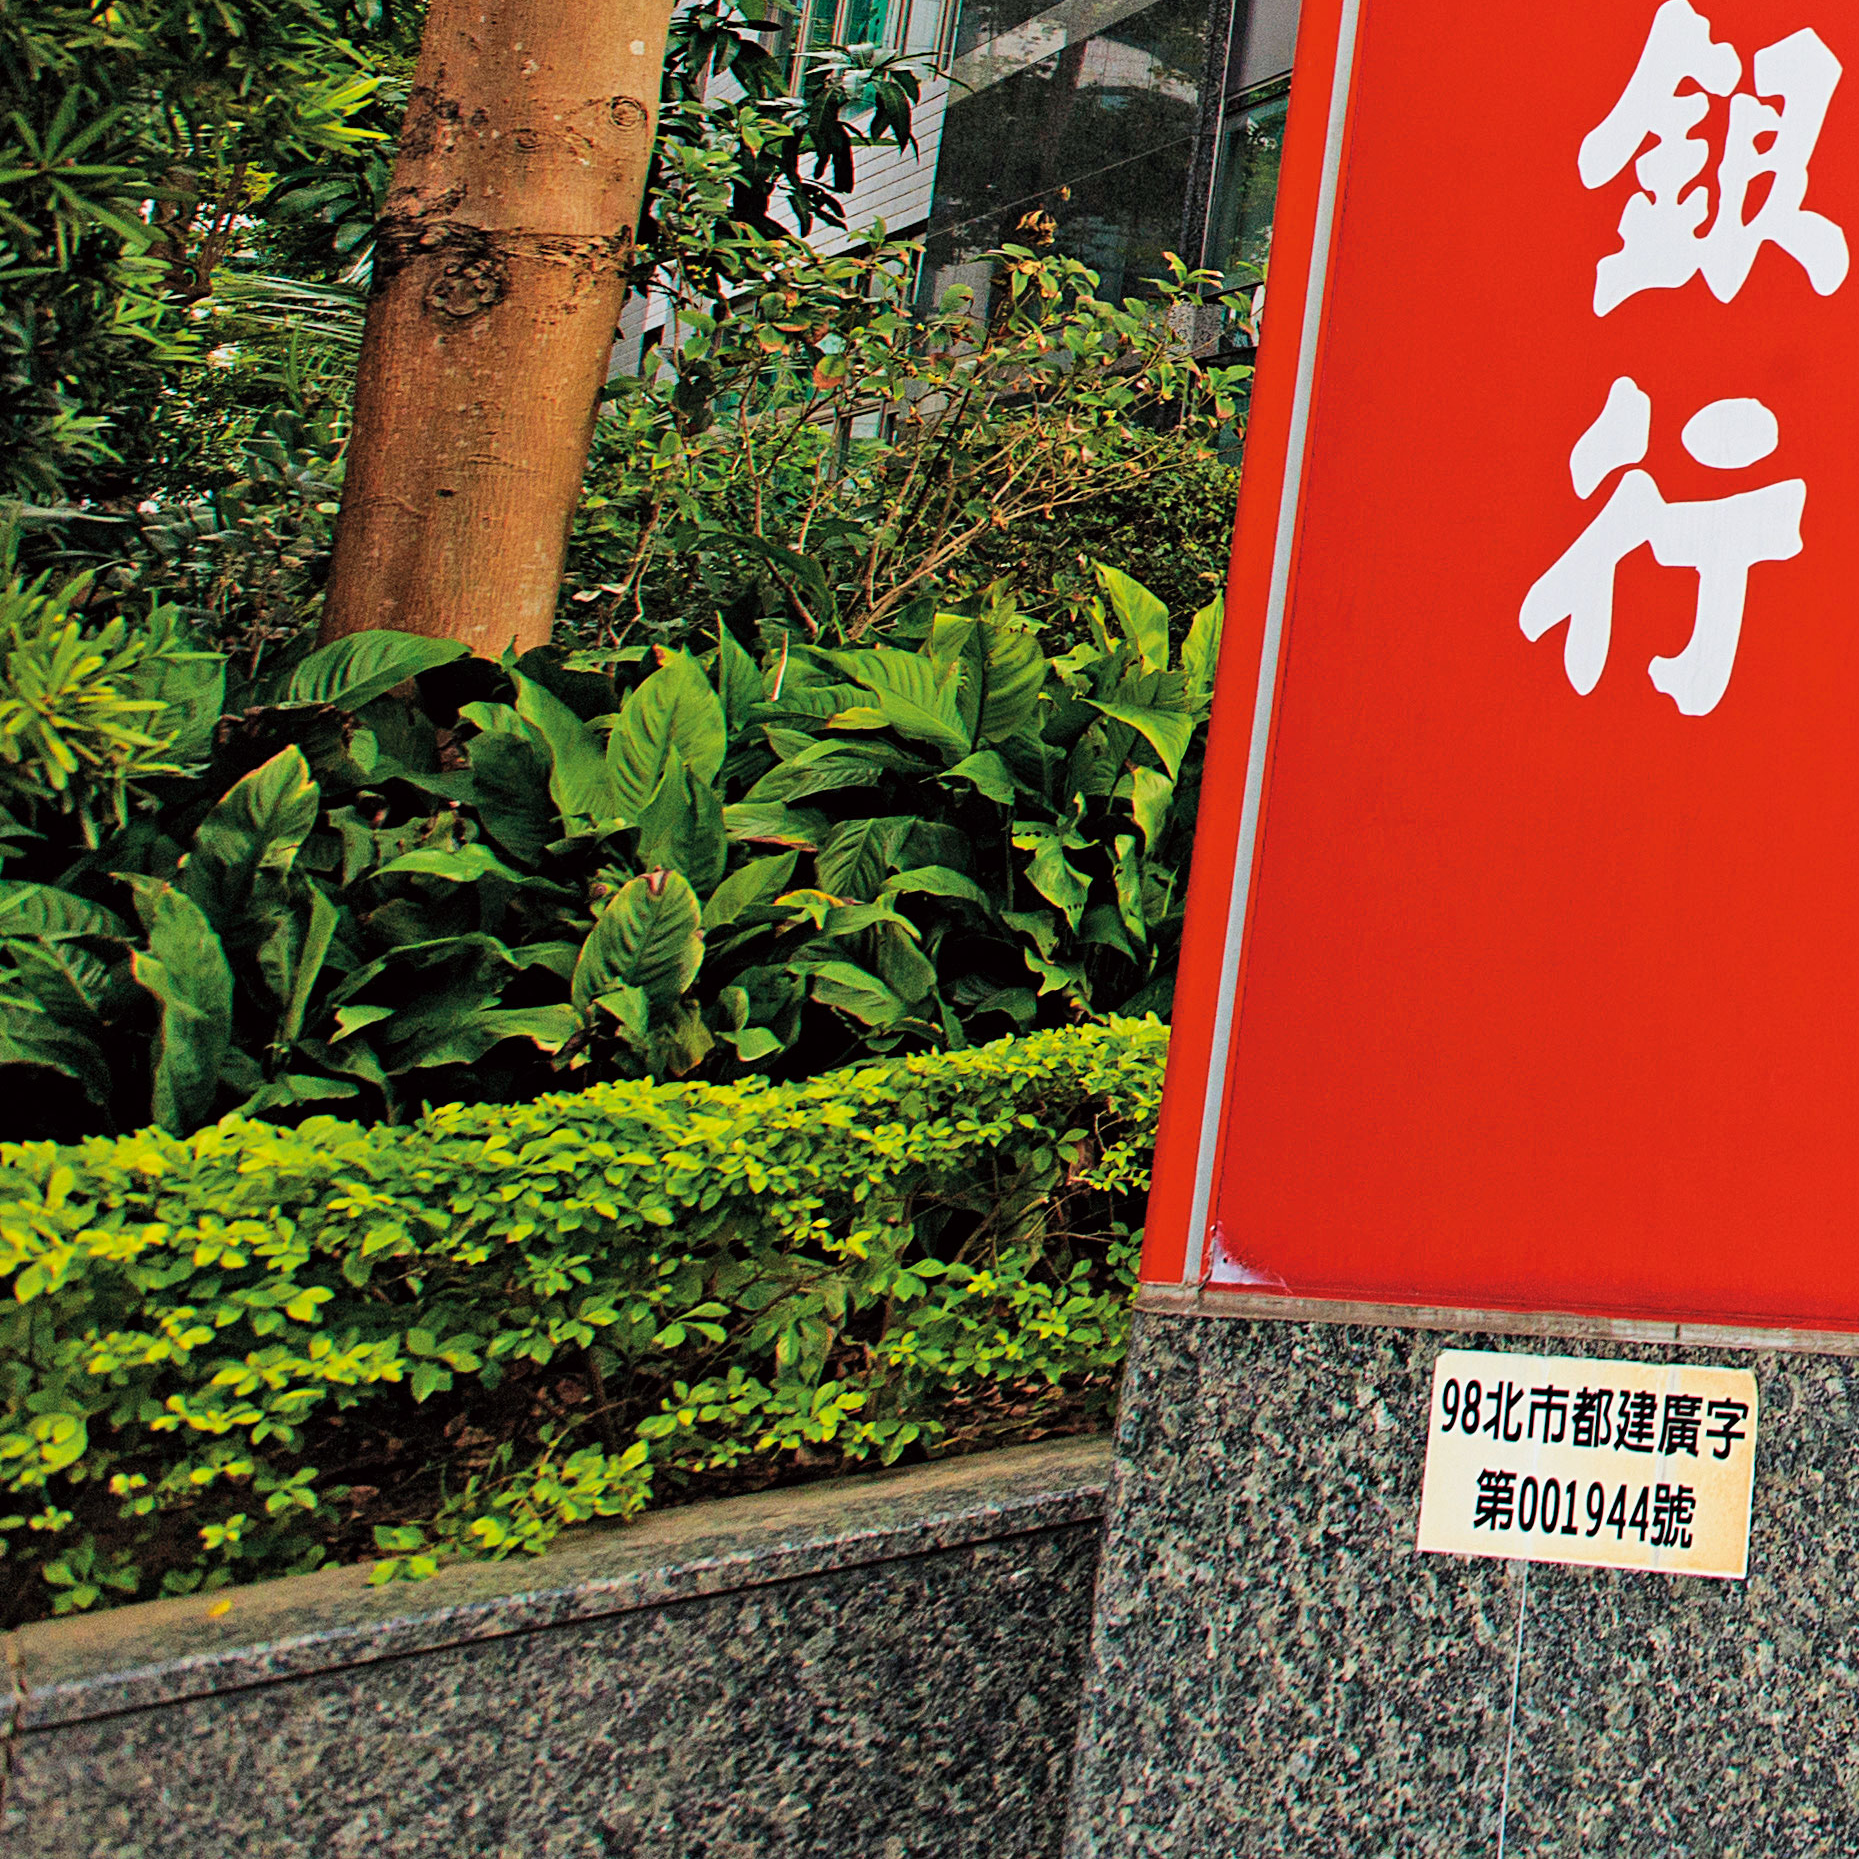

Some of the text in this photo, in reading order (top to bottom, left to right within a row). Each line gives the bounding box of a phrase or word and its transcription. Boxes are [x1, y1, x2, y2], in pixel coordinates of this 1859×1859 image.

[1440, 1378, 1750, 1460] 98北市都建廣字
[1473, 1469, 1697, 1550] 第001944號
